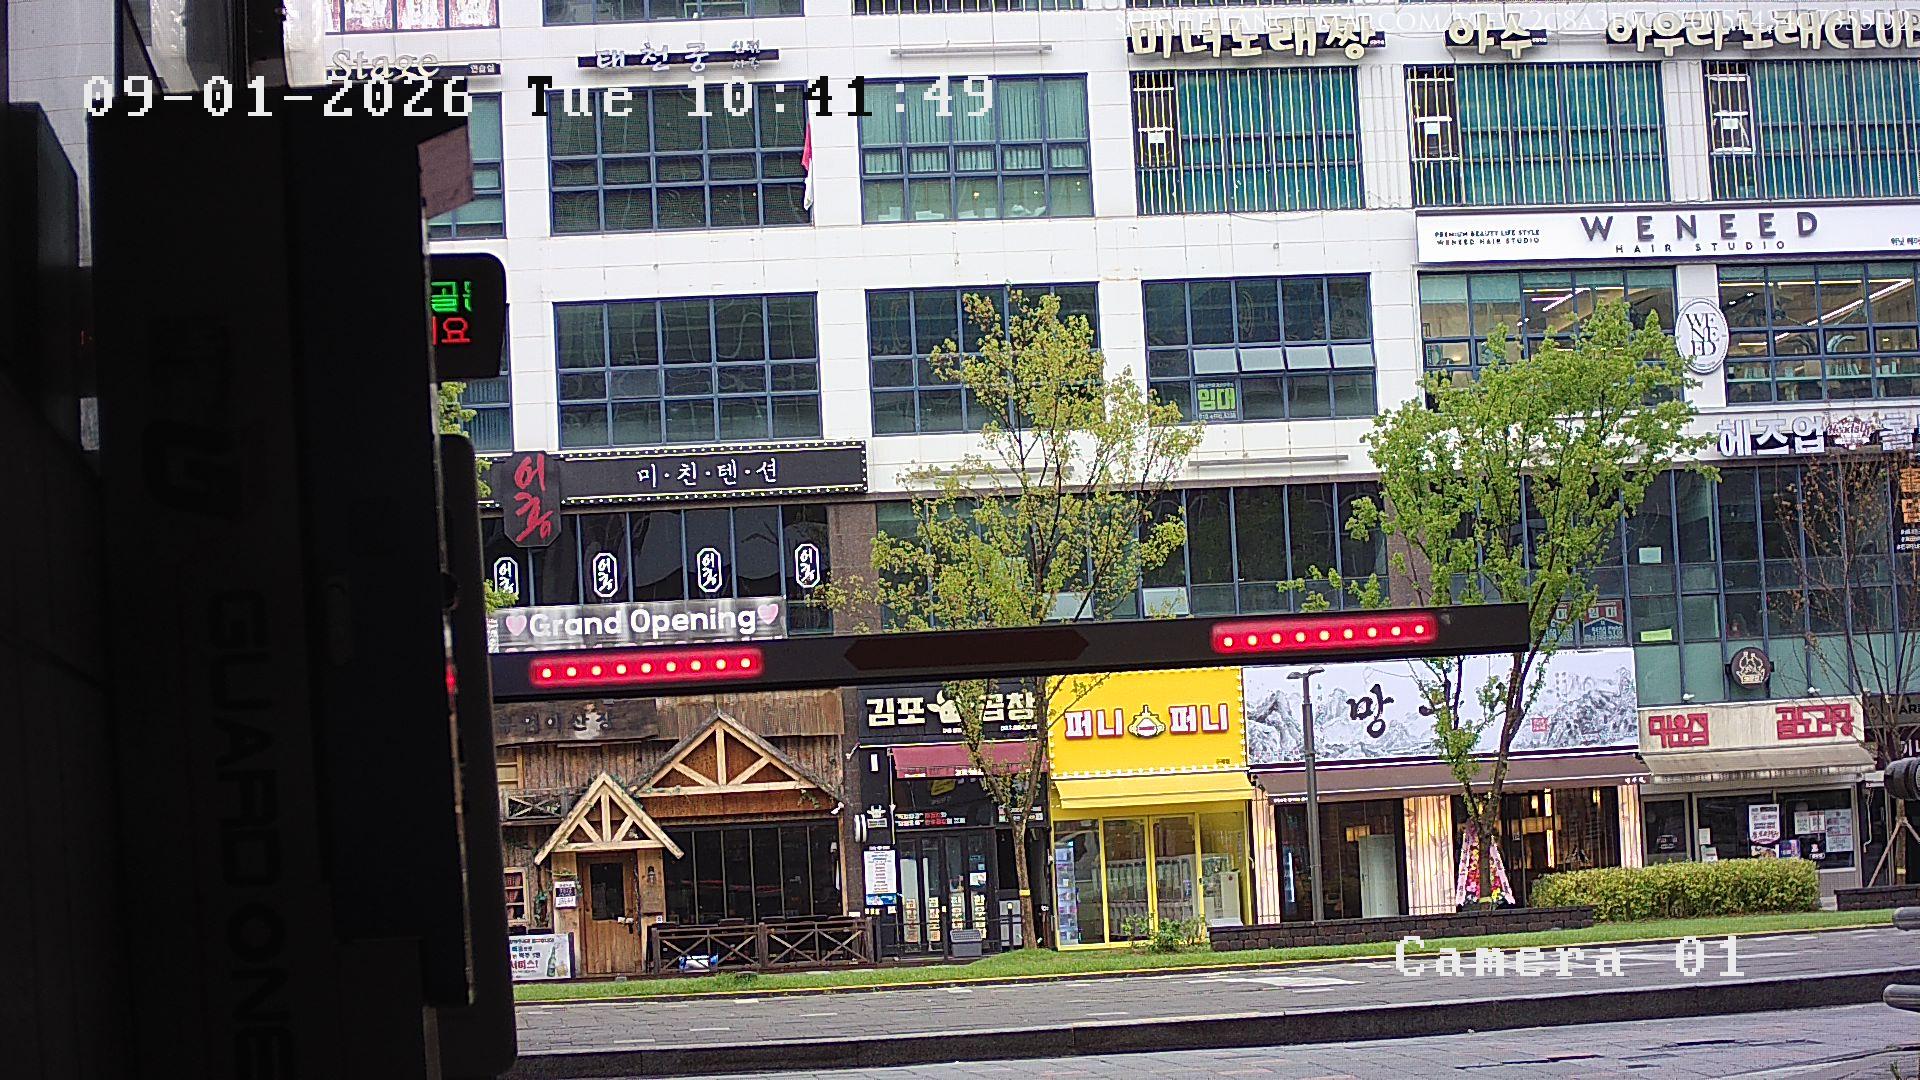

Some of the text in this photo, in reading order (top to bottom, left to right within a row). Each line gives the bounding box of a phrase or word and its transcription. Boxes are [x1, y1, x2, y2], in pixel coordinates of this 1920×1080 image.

[1580, 212, 1818, 242] WENEED
[1615, 240, 1785, 254] HAIR STUDIO
[1197, 388, 1236, 411] 임대
[1717, 416, 1825, 457] 헤즈업
[529, 611, 622, 637] Grand
[630, 607, 757, 639] Opening
[866, 696, 926, 728] 김포
[1064, 703, 1230, 740] 퍼니 퍼니
